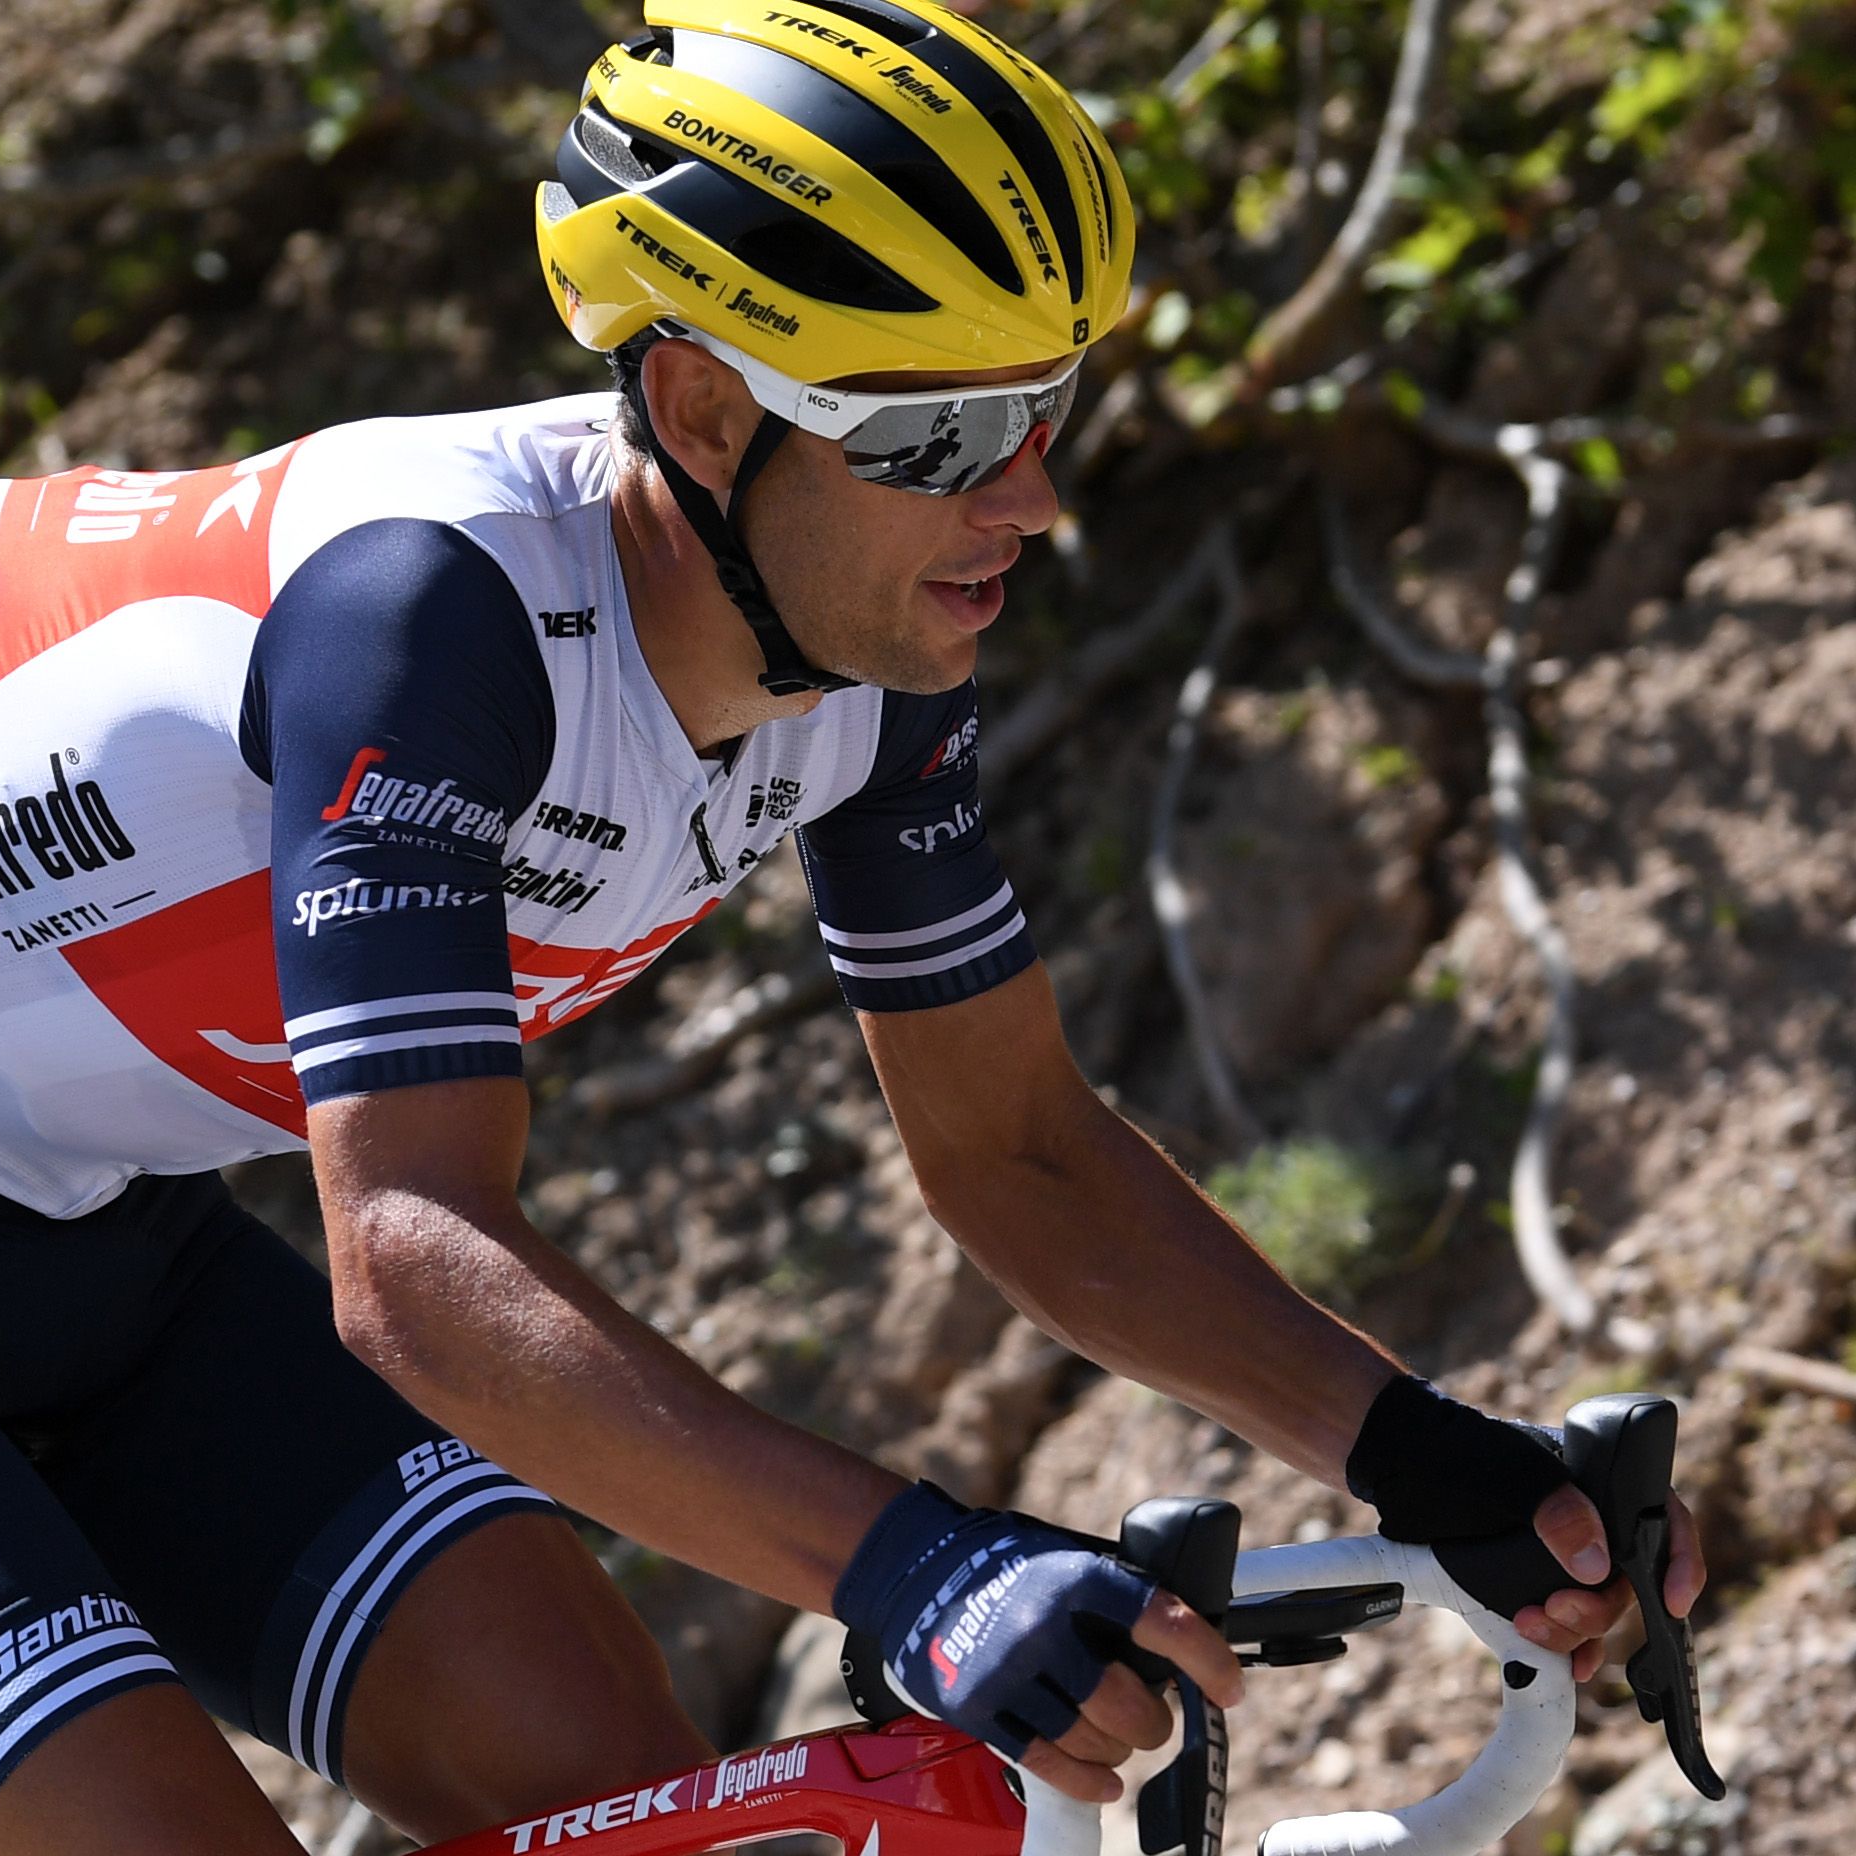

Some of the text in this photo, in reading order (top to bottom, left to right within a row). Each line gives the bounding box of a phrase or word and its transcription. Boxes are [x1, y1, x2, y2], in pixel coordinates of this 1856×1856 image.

[764, 10, 952, 115] TREK Segafredo
[662, 109, 834, 208] BONTRAGER
[614, 209, 801, 338] TREK Segafredo
[997, 169, 1061, 284] TREK
[320, 746, 508, 848] Segafredo
[376, 828, 457, 856] ZANETTI
[1, 901, 108, 952] ZANETTI
[894, 1533, 1020, 1683] TREK
[928, 1553, 1029, 1690] Segafredo
[503, 1740, 809, 1855] TREK Segafredo
[744, 1791, 784, 1810] ZANETTI
